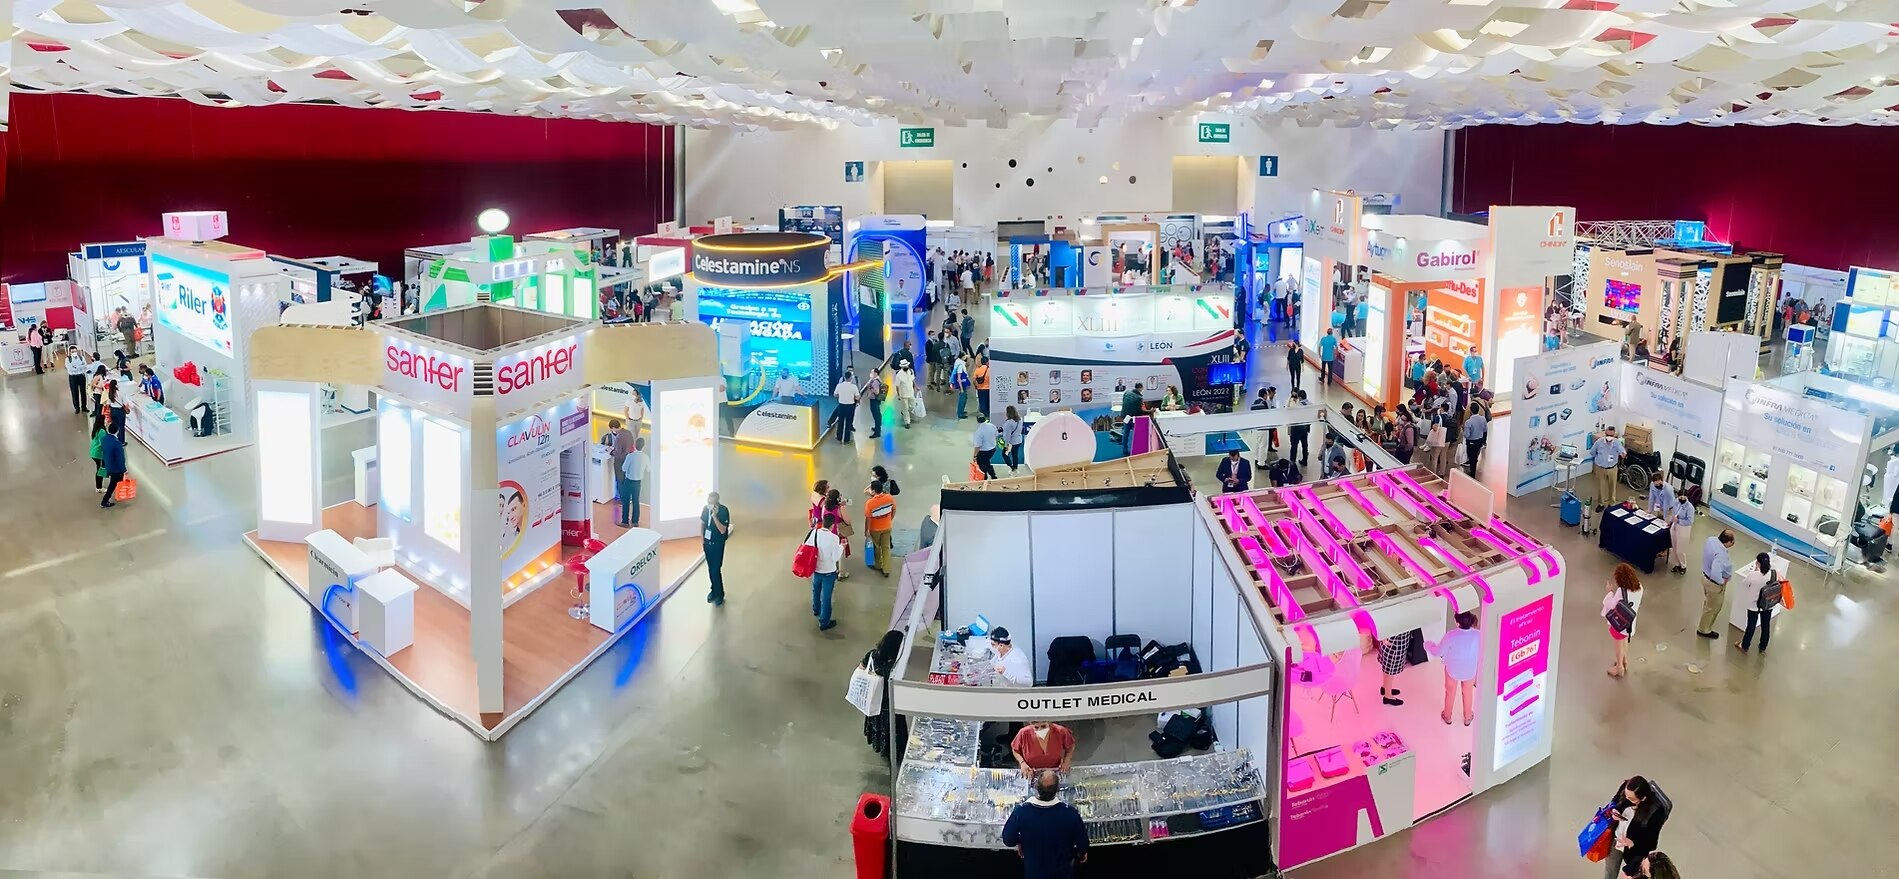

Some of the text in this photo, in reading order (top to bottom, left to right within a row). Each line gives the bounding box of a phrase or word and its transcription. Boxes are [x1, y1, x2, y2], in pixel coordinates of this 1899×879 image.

[695, 254, 780, 275] Celestamine
[1416, 249, 1476, 268] Gabirol
[178, 284, 208, 316] Riler
[1150, 341, 1173, 350] LEÓN
[386, 345, 464, 393] sanfer
[497, 344, 577, 395] sanfer
[1211, 354, 1230, 364] XLIII
[1192, 388, 1212, 397] LEÓN
[756, 409, 798, 421] Celestamine
[1763, 412, 1812, 435] Su solución en
[507, 420, 552, 448] CLAVULIN
[537, 433, 550, 446] 12h
[630, 548, 657, 576] ORELOX
[1510, 629, 1541, 649] Tebonin
[1017, 690, 1157, 711] OUTLET MEDICAL
